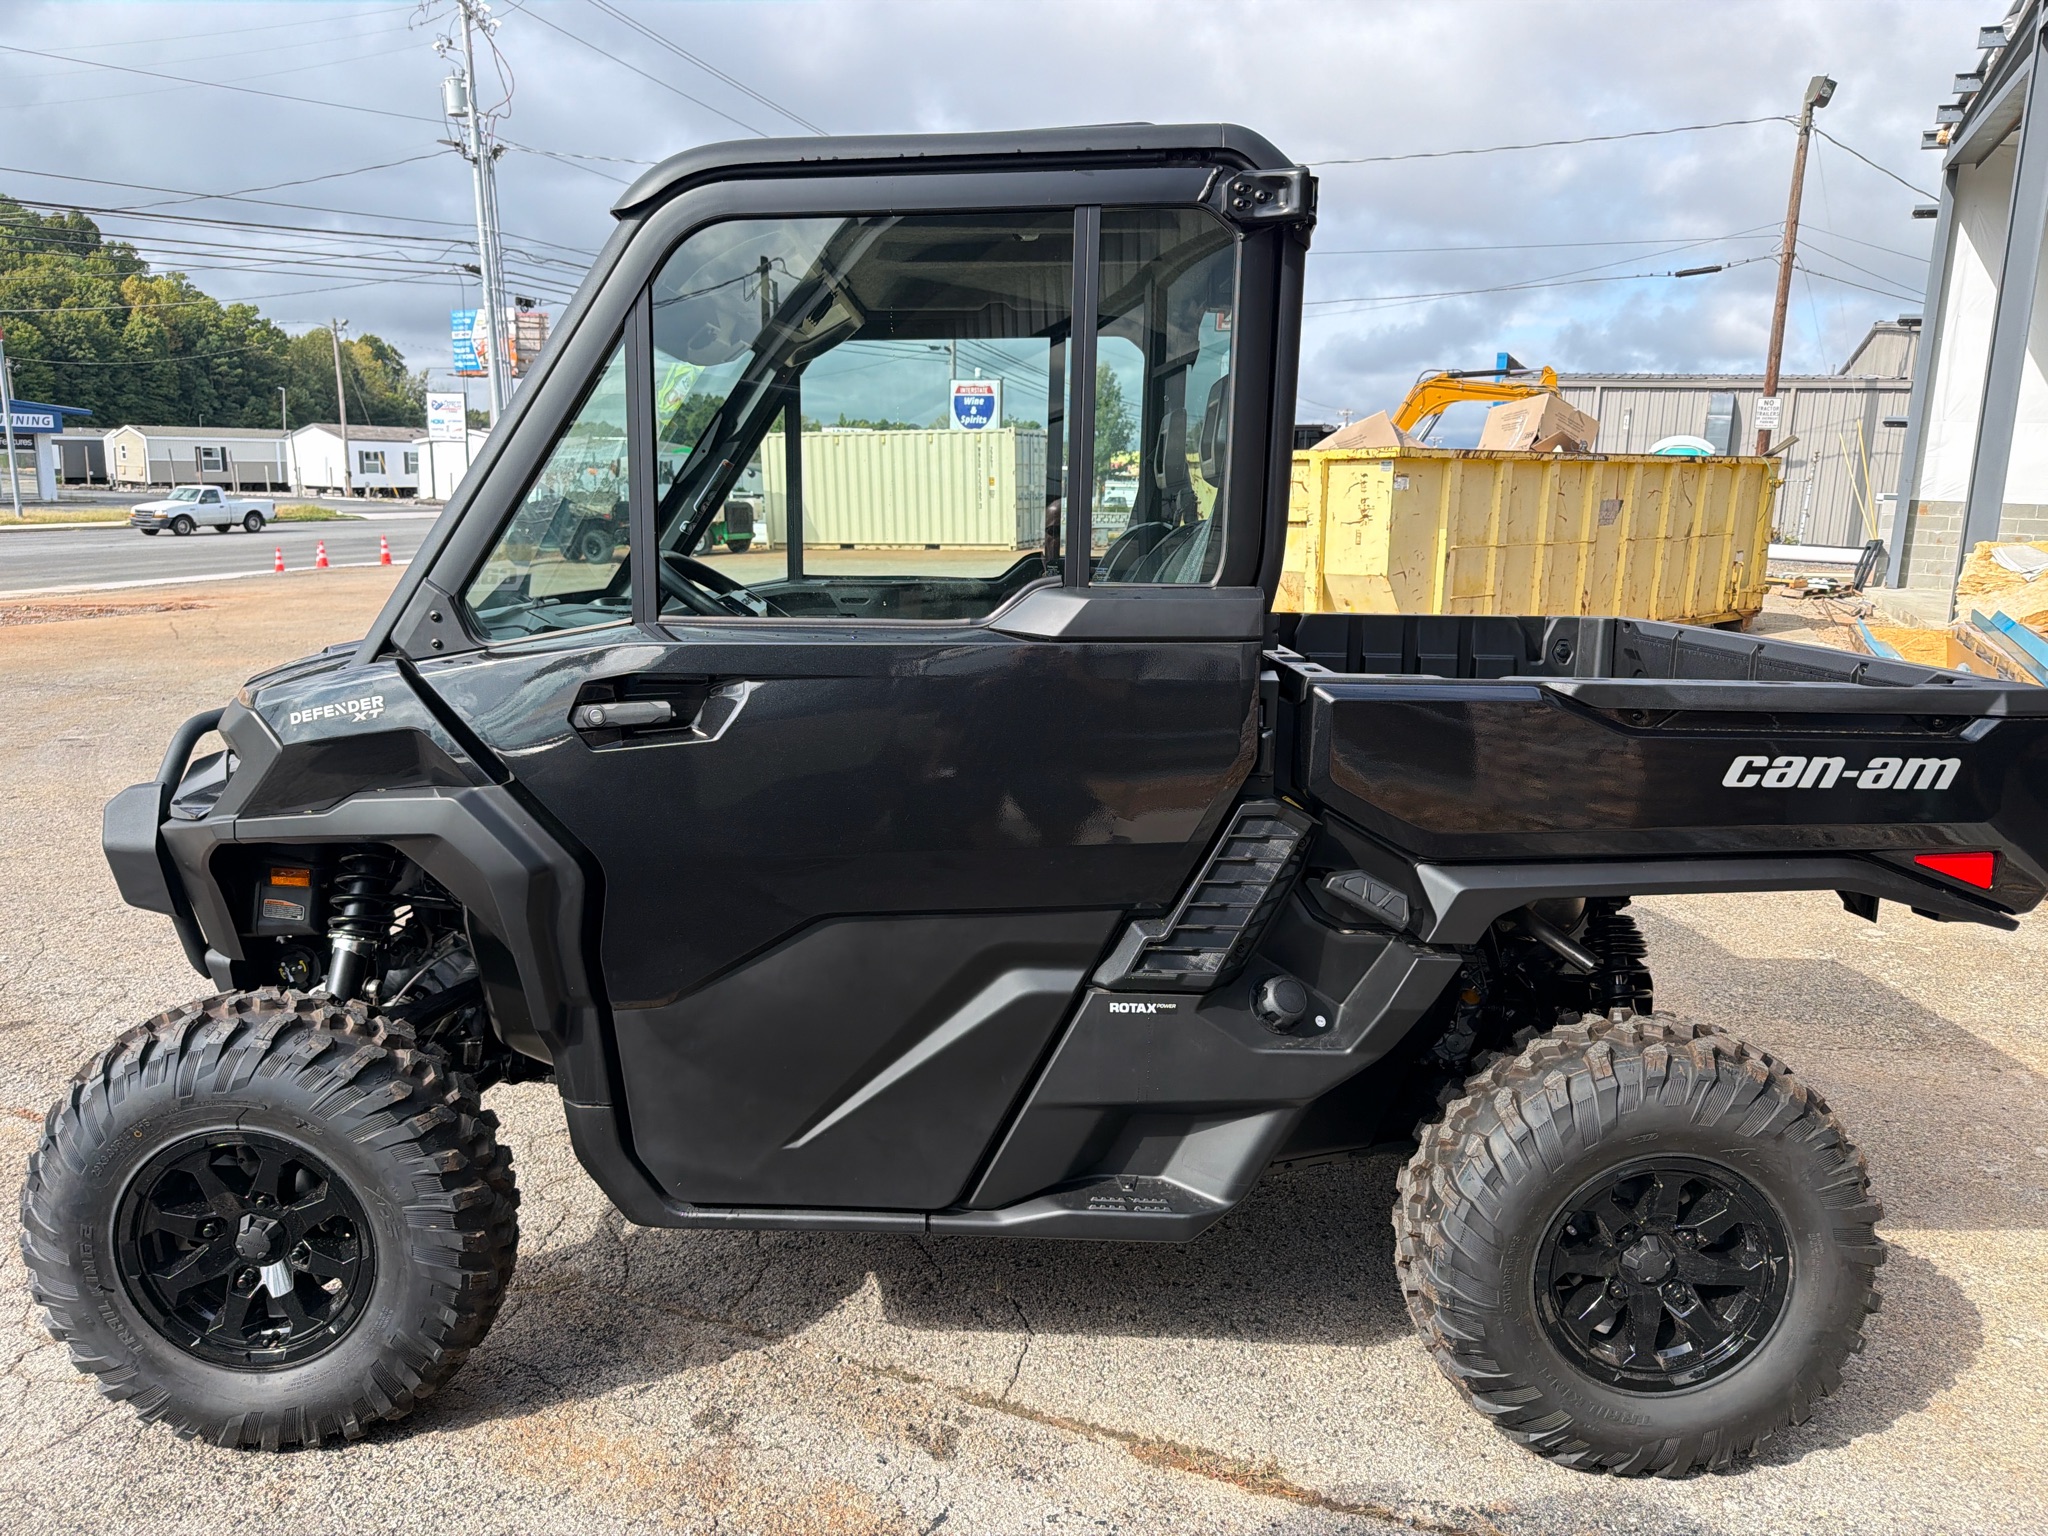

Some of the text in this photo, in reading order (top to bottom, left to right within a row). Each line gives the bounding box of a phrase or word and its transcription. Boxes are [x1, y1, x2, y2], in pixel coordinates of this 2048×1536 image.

[963, 397, 985, 405] Wine
[970, 406, 977, 414] &
[960, 415, 987, 425] Spirits
[290, 695, 384, 725] DEFENDER
[351, 708, 384, 722] XT
[1721, 755, 1962, 790] can-am
[1109, 1002, 1157, 1013] ROTAX
